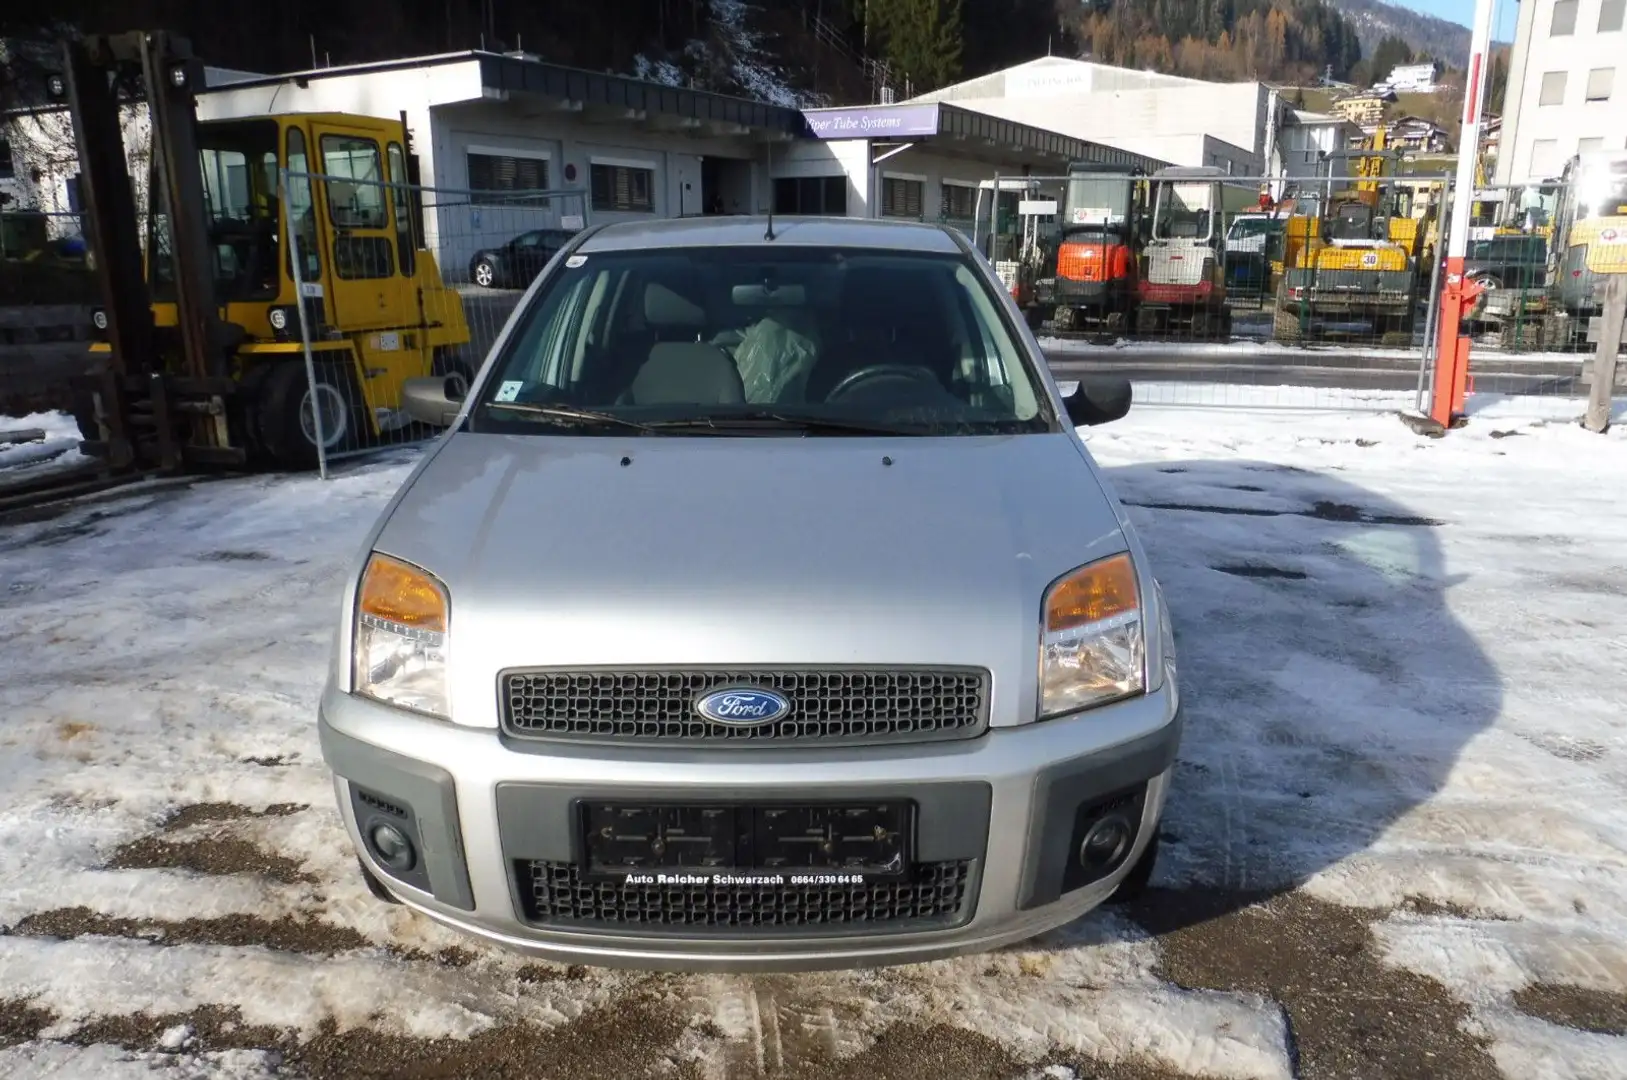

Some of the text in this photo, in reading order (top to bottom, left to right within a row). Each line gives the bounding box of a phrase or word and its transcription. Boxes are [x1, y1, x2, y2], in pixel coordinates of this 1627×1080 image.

[834, 116, 858, 130] Tube
[861, 115, 901, 132] Systems
[1363, 255, 1376, 265] 30
[718, 695, 768, 716] Ford
[625, 873, 654, 884] Auto
[712, 873, 784, 885] Schwarzach
[837, 874, 850, 884] 64
